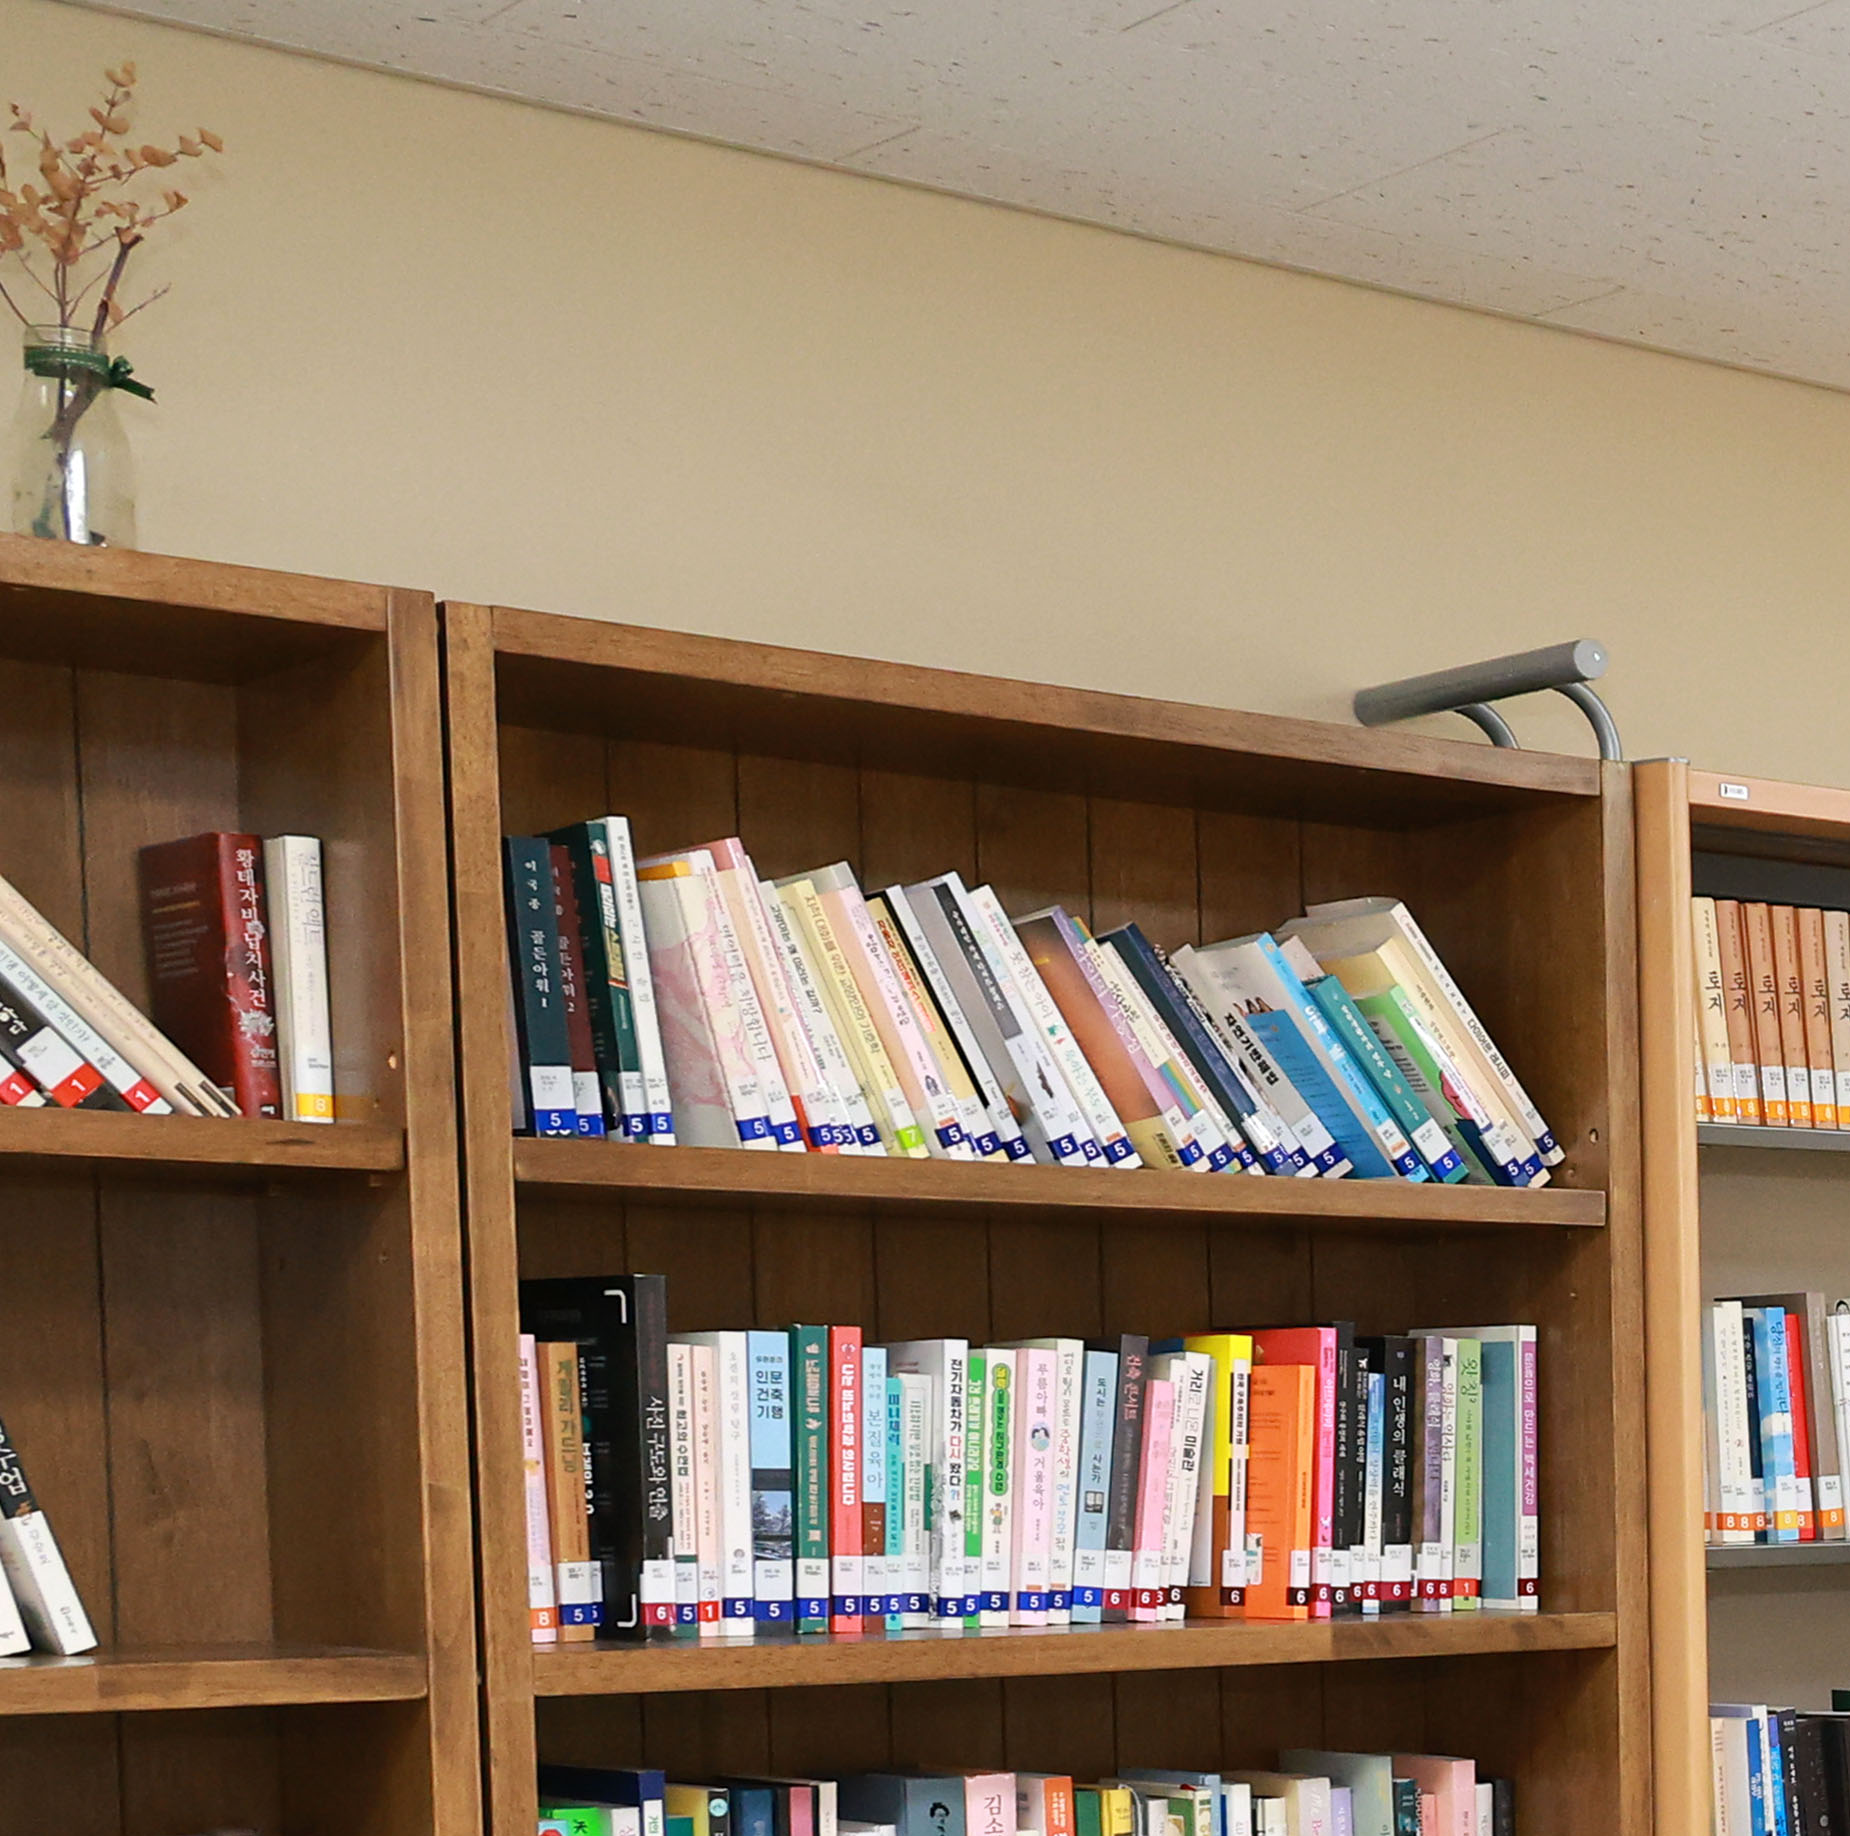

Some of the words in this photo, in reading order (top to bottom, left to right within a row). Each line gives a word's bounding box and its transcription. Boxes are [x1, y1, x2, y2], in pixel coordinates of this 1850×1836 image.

[236, 849, 261, 921] 황태자비
[245, 933, 266, 1006] 납치사건
[1705, 972, 1723, 1017] 토지
[1759, 974, 1776, 1021] 토지
[10, 1081, 22, 1095] 1
[551, 1113, 561, 1126] 5
[754, 1122, 764, 1134] 5
[981, 1138, 993, 1151] 5
[755, 1370, 784, 1385] 인문
[839, 1363, 854, 1386] 나는
[756, 1387, 784, 1402] 건축
[948, 1358, 962, 1432] 전기자동차가
[644, 1395, 666, 1430] 사진
[757, 1405, 784, 1420] 기행
[948, 1435, 962, 1459] 다시
[1180, 1434, 1198, 1472] 미술관
[645, 1432, 668, 1483] 구도와
[840, 1448, 856, 1505] 의사입니다
[1170, 1587, 1181, 1601] 6
[1425, 1581, 1435, 1595] 6
[909, 1596, 920, 1610] 5
[1111, 1592, 1121, 1605] 6
[705, 1605, 713, 1618] 1
[645, 1815, 659, 1834] 거의
